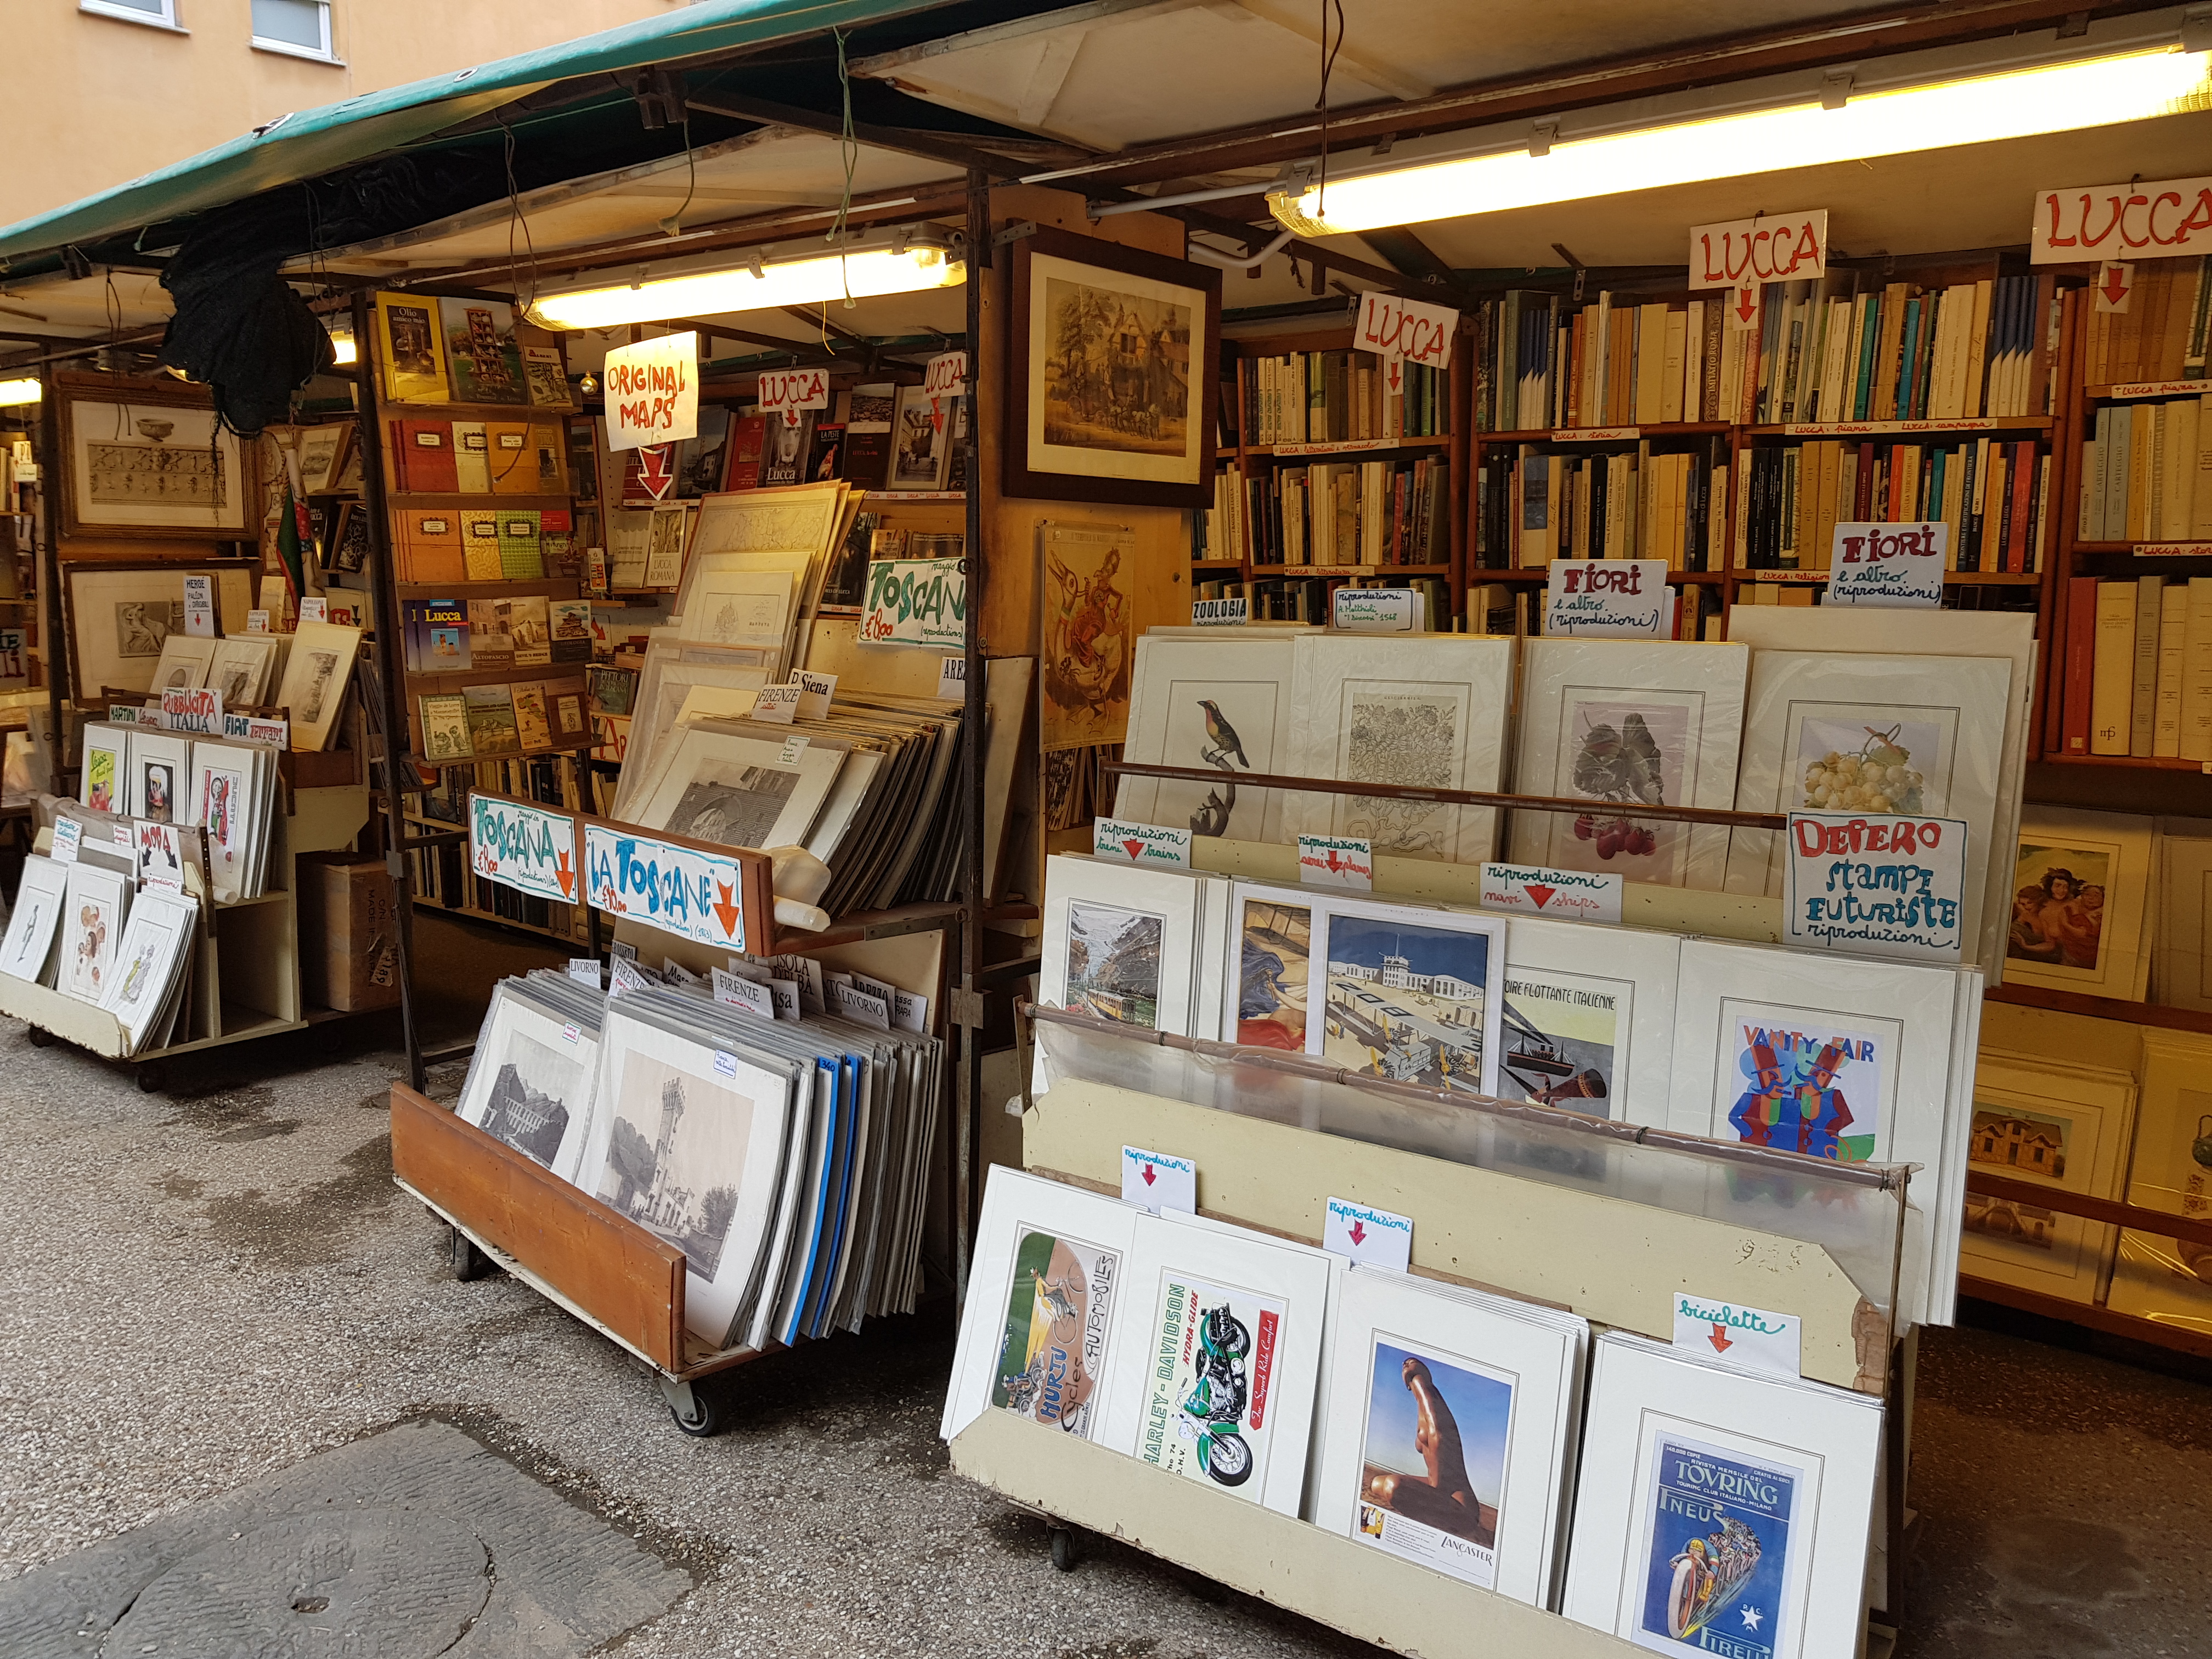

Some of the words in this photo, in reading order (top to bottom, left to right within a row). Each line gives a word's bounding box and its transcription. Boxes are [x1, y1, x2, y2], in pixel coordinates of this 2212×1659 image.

[2047, 188, 2212, 247] LUCCA
[1701, 221, 1819, 282] LUCCA
[399, 307, 416, 317] Olio
[1365, 298, 1443, 366] LUCCA
[608, 360, 685, 397] ORIGINAL
[926, 358, 962, 394] LUCCA
[1707, 357, 1717, 393] IMITATIO
[760, 373, 825, 407] LUCCA
[2123, 386, 2153, 396] LUCCA
[620, 397, 675, 429] MAPS
[1555, 432, 1577, 440] LUCCA
[1588, 431, 1621, 439] storia
[1835, 425, 1872, 434] piana
[1279, 446, 1299, 454] LUCCA
[767, 467, 795, 481] Lucca
[2096, 447, 2104, 493] CARTEGGIO
[2114, 446, 2123, 492] CARTEGGIO
[1842, 524, 1937, 563] FIORI
[2143, 545, 2181, 555] LUCCA
[1564, 563, 1642, 596] FIORI
[1853, 565, 1908, 583] altro
[870, 562, 966, 625] TOSCAN
[1338, 591, 1402, 606] riproduzioni
[424, 609, 462, 622] Lucca
[1193, 598, 1246, 619] ZOOLOGIA
[601, 670, 629, 682] PITTORI
[801, 673, 828, 696] Siena
[758, 688, 801, 703] FIRENZE
[170, 712, 210, 733] ITALIA
[140, 825, 171, 853] MODA
[475, 798, 558, 871] TOSCANA
[1100, 822, 1187, 846] riproduzioni
[1298, 836, 1369, 854] riproduzioni
[1793, 819, 1942, 857] DEPERO
[1096, 836, 1122, 853] treni
[1144, 842, 1181, 861] trains
[1487, 865, 1609, 890] riproduzioni
[1484, 890, 1522, 904] navi
[1552, 889, 1600, 918] ships
[1807, 924, 1953, 947] riproduzioni
[571, 960, 599, 975] LIVORNO
[776, 953, 810, 977] ISOLA
[719, 974, 760, 1003] FIRENZE
[895, 995, 912, 1006] assa
[1525, 982, 1572, 1003] FLOTTANTE
[1573, 989, 1615, 1011] ITALIENNE
[841, 988, 884, 1018] LIVORNO
[1743, 1024, 1817, 1053] VANITY
[1831, 1036, 1875, 1063] FAIR
[1124, 1147, 1190, 1173] riproduzioni
[1329, 1200, 1410, 1233] riproduzioni
[1086, 1255, 1114, 1358] AUTOMOBILES
[1678, 1299, 1786, 1335] biciclette
[1182, 1289, 1199, 1368] HYDRA-GLIDE
[1260, 1319, 1274, 1350] Comfort
[1143, 1393, 1169, 1466] HARLEY
[1157, 1283, 1185, 1381] DAVIDSON
[1258, 1351, 1269, 1372] Ride
[1040, 1345, 1068, 1420] HURTU
[1060, 1356, 1085, 1433] Cycles
[1254, 1374, 1267, 1400] Superb
[1170, 1443, 1176, 1454] 74
[1691, 1458, 1716, 1470] RIVISTA
[1718, 1466, 1748, 1479] MENSILE
[1750, 1475, 1763, 1483] DEL
[1753, 1470, 1771, 1479] GRATIS
[1677, 1480, 1701, 1491] TOURING
[1702, 1488, 1718, 1496] CLUB
[1441, 1536, 1492, 1567] LANCASTER
